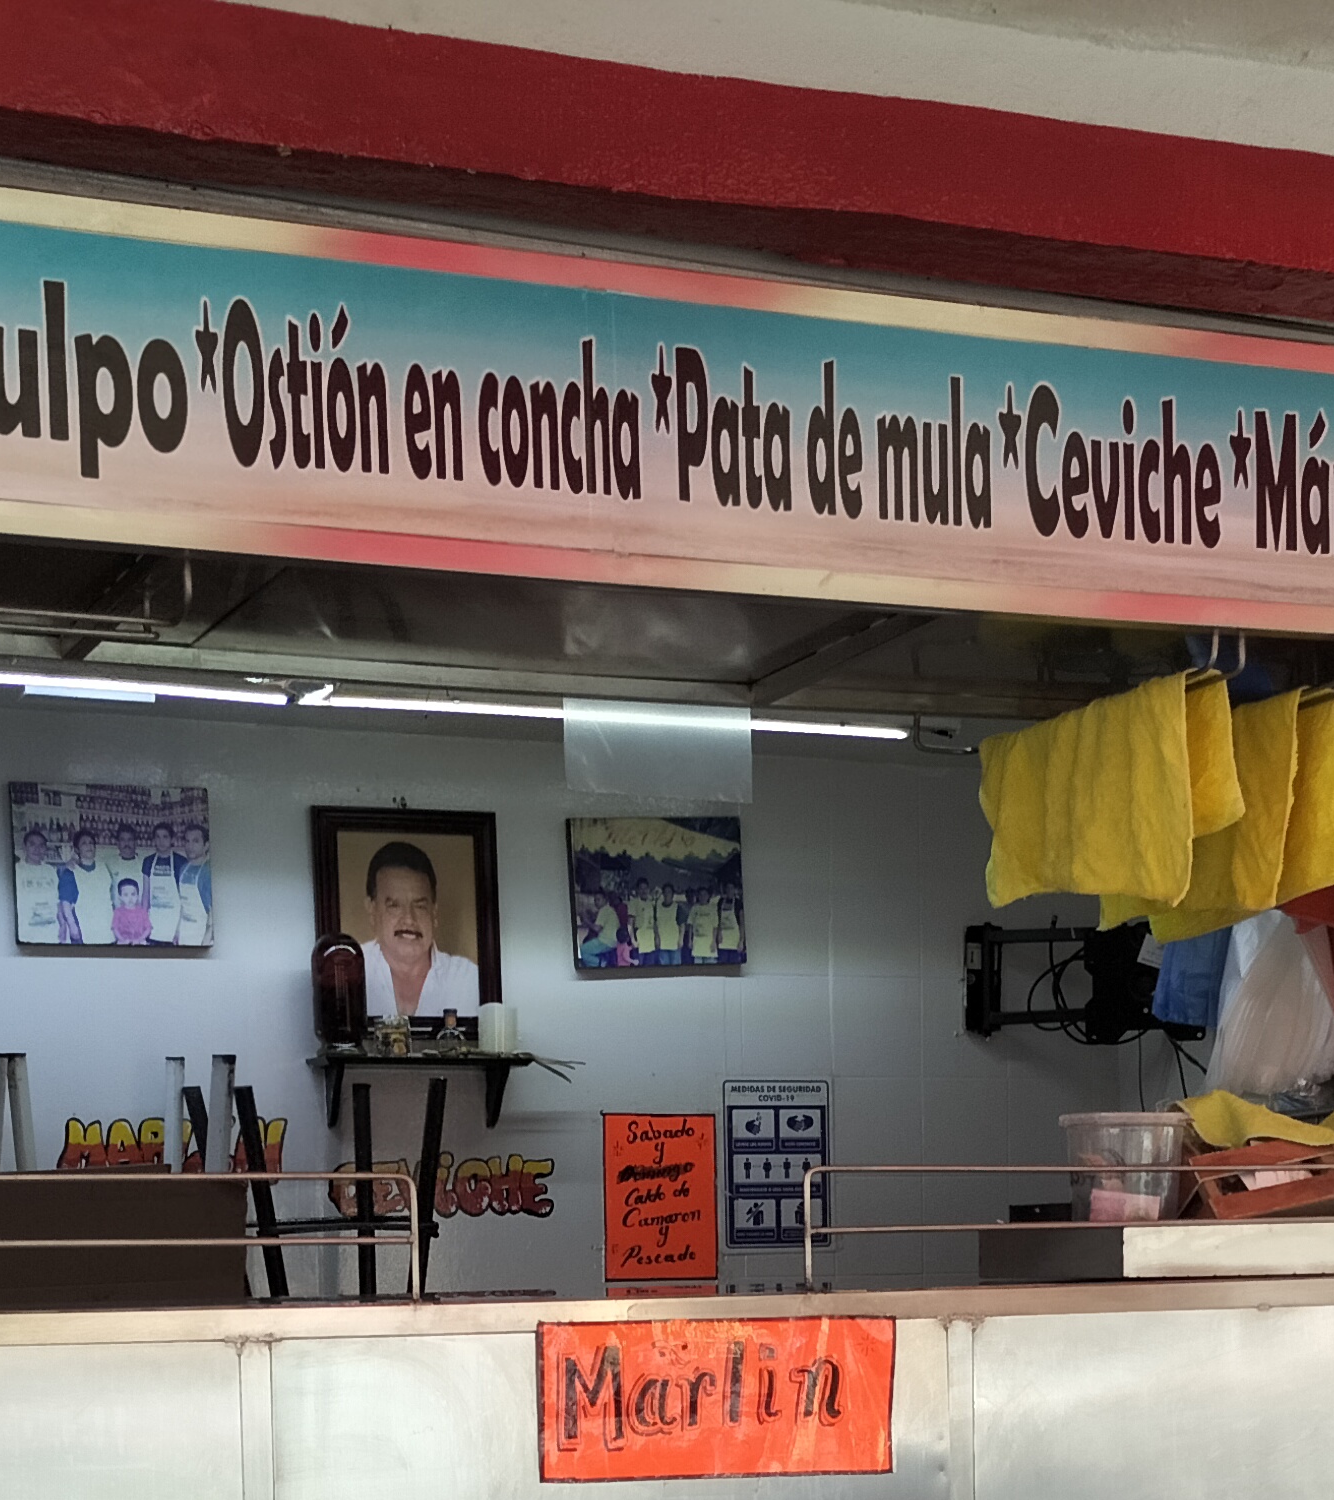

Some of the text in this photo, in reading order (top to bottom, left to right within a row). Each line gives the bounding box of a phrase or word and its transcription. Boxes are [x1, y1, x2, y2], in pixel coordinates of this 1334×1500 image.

[222, 298, 389, 474] Ostión
[405, 363, 463, 481] en
[478, 338, 641, 500] concha
[675, 346, 791, 511] Pata
[807, 360, 863, 519] de
[877, 376, 992, 528] mula
[1024, 384, 1222, 549] Ceviche
[627, 1119, 695, 1144] Sabado
[653, 1142, 665, 1164] y
[673, 1181, 690, 1198] de
[657, 1225, 669, 1248] y
[621, 1245, 696, 1268] Pescado
[557, 1340, 843, 1452] Marlin
